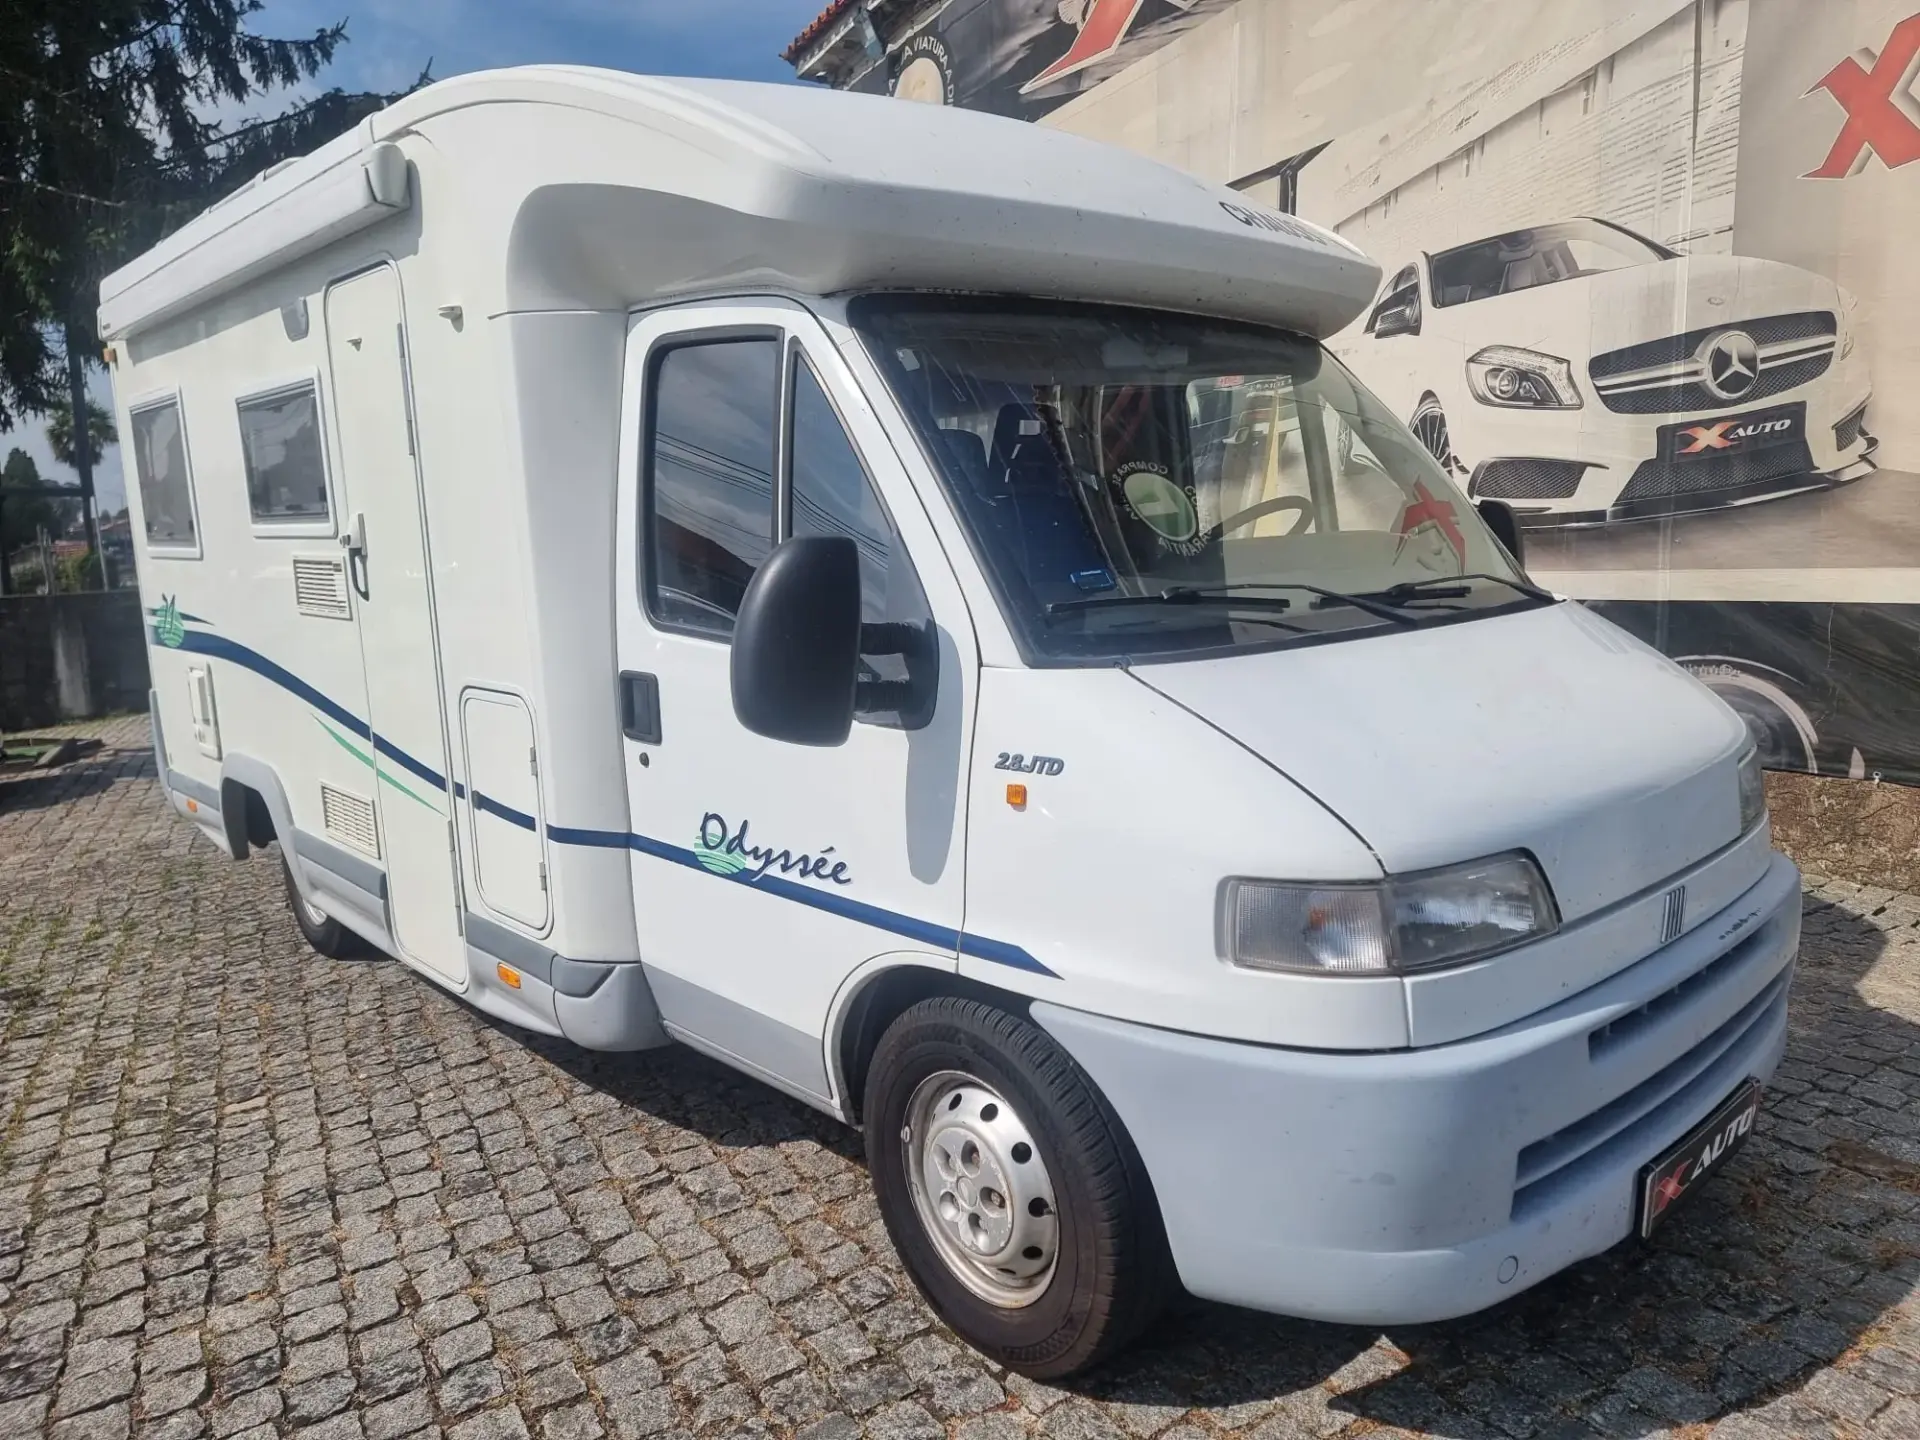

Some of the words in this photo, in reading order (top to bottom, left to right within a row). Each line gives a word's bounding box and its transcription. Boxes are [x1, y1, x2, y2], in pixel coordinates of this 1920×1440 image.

[913, 35, 948, 70] VIATURA
[1728, 418, 1792, 440] AUTO
[700, 811, 853, 883] Odyssée
[1690, 1103, 1757, 1181] AUTO
